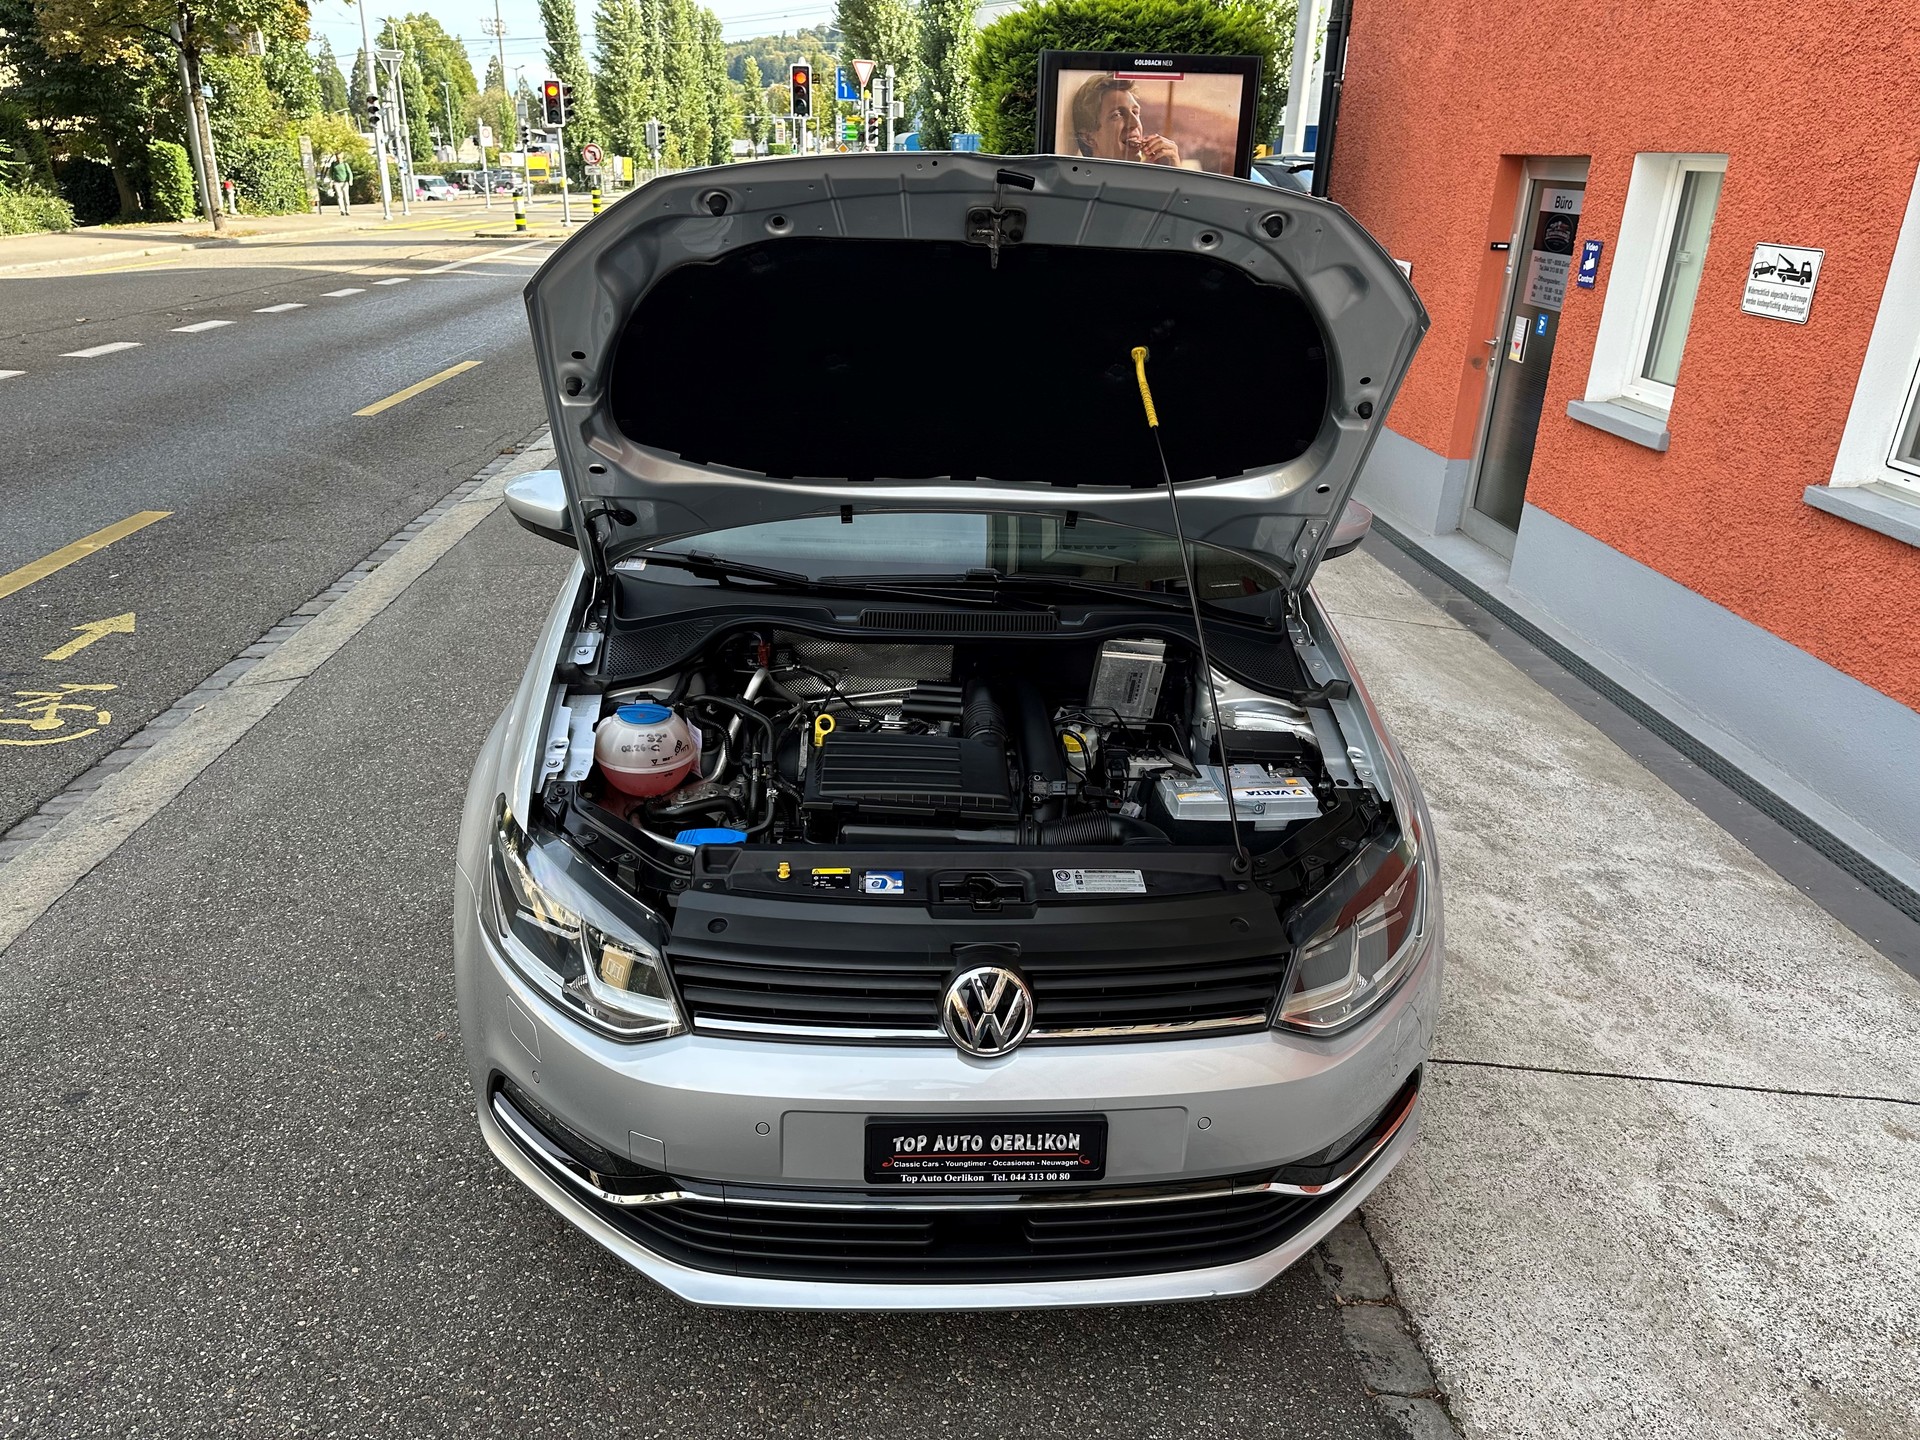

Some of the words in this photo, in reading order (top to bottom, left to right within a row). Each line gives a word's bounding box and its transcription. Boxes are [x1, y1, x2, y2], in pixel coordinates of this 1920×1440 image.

[1555, 195, 1573, 210] Büro
[1586, 242, 1599, 252] Video
[1577, 274, 1595, 284] Control
[893, 1134, 928, 1152] TOP
[933, 1134, 983, 1152] AUTO
[990, 1132, 1081, 1151] OERLIKON
[922, 1160, 939, 1168] Cars
[945, 1160, 986, 1168] Youngtimer
[1041, 1159, 1079, 1167] Neuwagen
[900, 1174, 918, 1184] Top
[919, 1174, 942, 1182] Auto
[944, 1173, 985, 1182] Oerlikon
[991, 1173, 1008, 1181] Tel.
[1010, 1173, 1026, 1181] 044
[1028, 1172, 1044, 1181] 313
[1046, 1172, 1057, 1181] 00
[1059, 1172, 1071, 1181] 80
